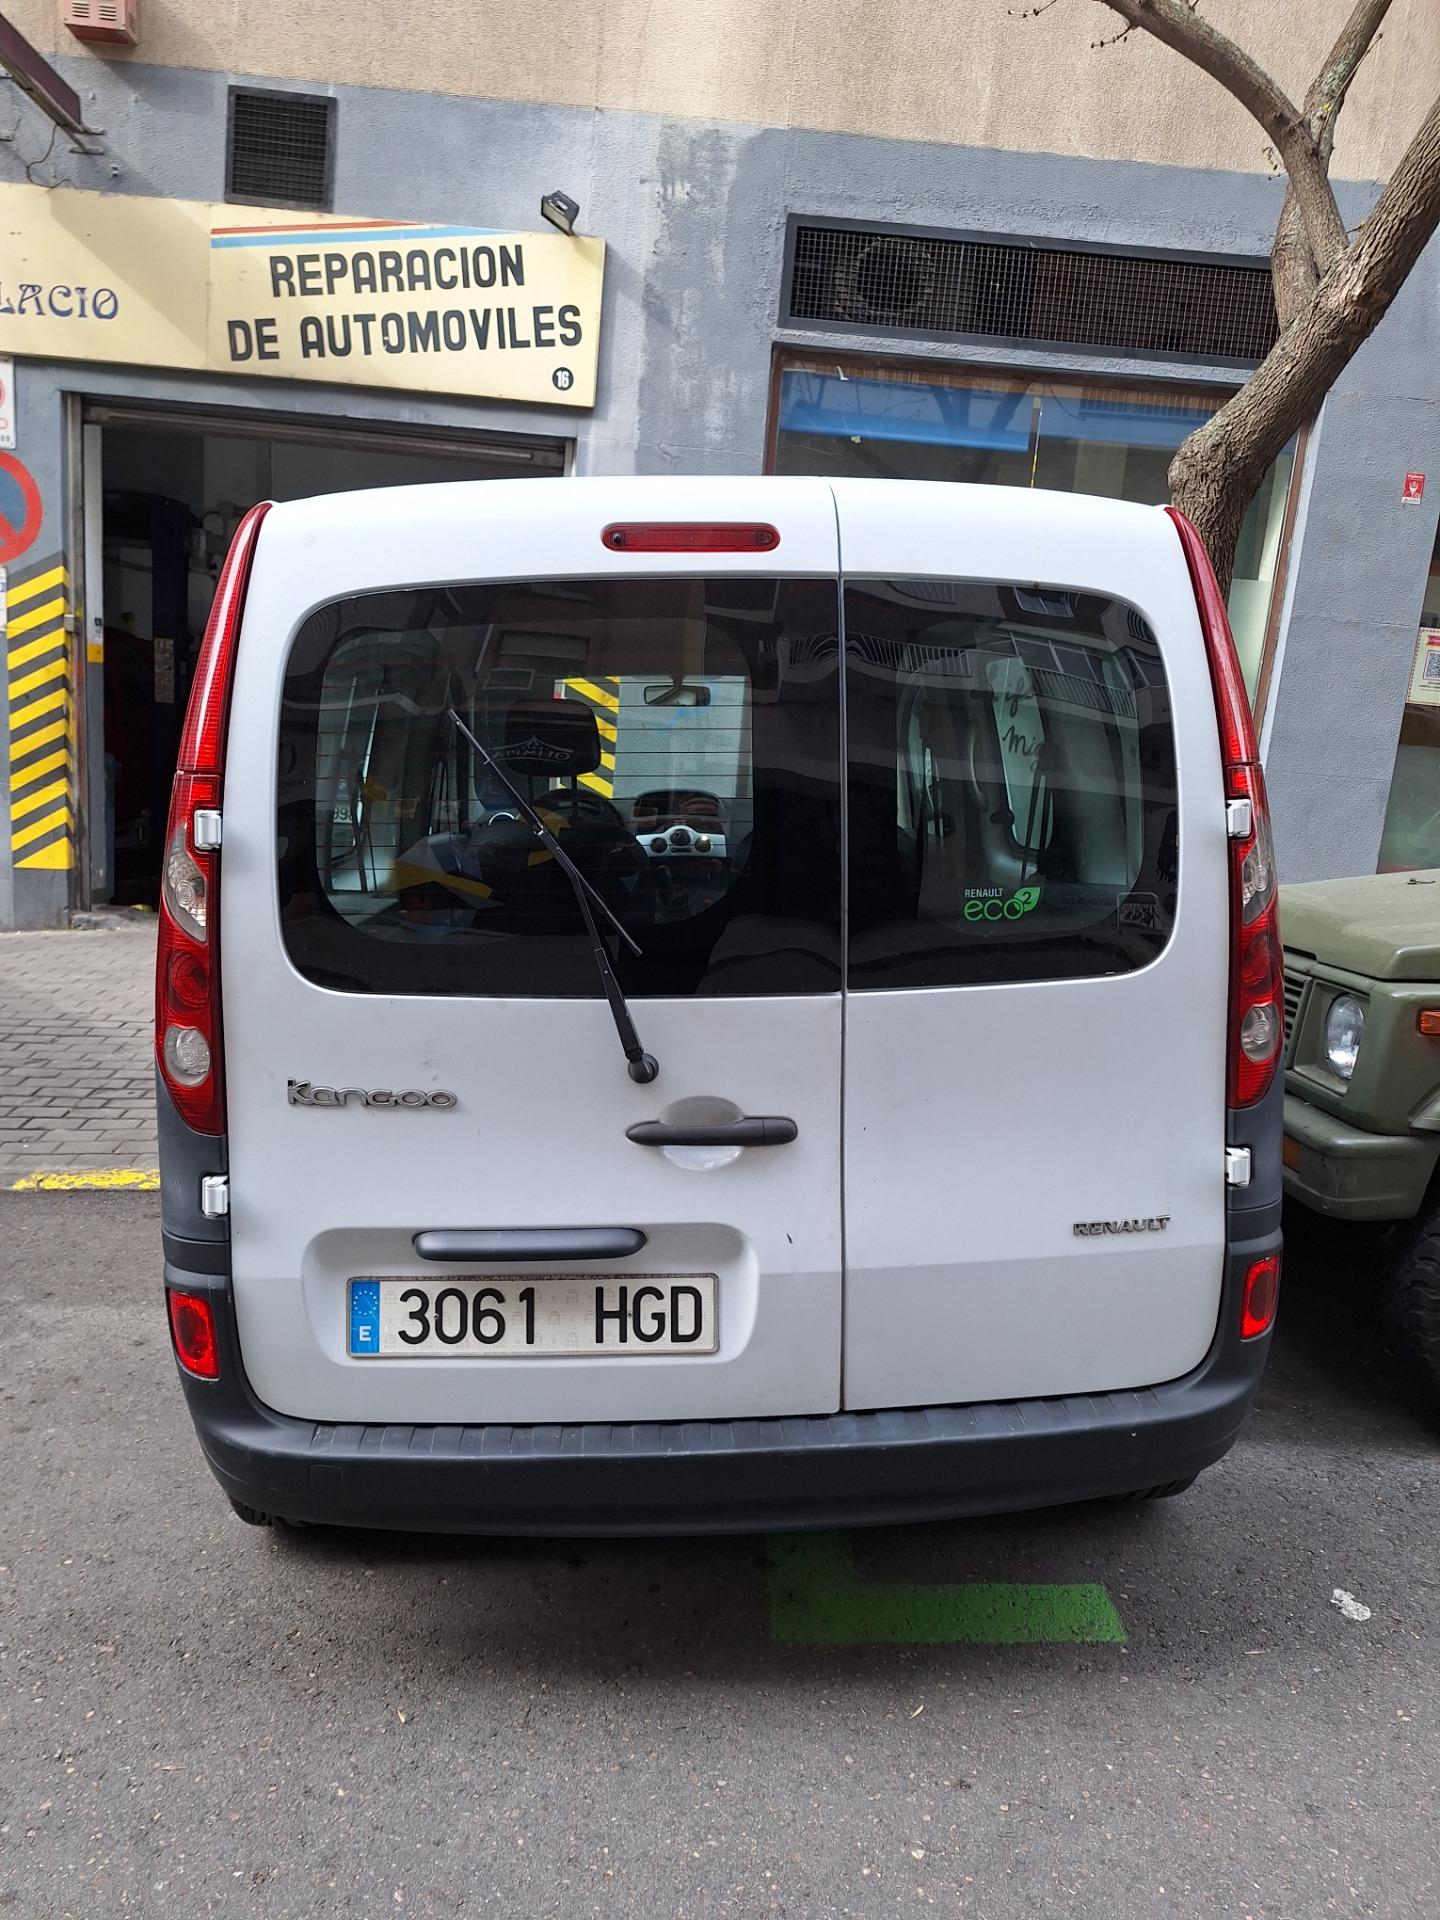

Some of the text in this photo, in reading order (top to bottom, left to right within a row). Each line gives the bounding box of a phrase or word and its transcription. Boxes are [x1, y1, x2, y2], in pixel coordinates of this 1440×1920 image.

[269, 244, 525, 298] REPARACION
[227, 304, 582, 362] DE AUTOMOVILES
[555, 370, 570, 389] 16
[964, 887, 1004, 898] RENAULT
[1073, 1215, 1171, 1236] RENAULT
[397, 1285, 703, 1345] 3061 HGD
[358, 1325, 372, 1342] E
